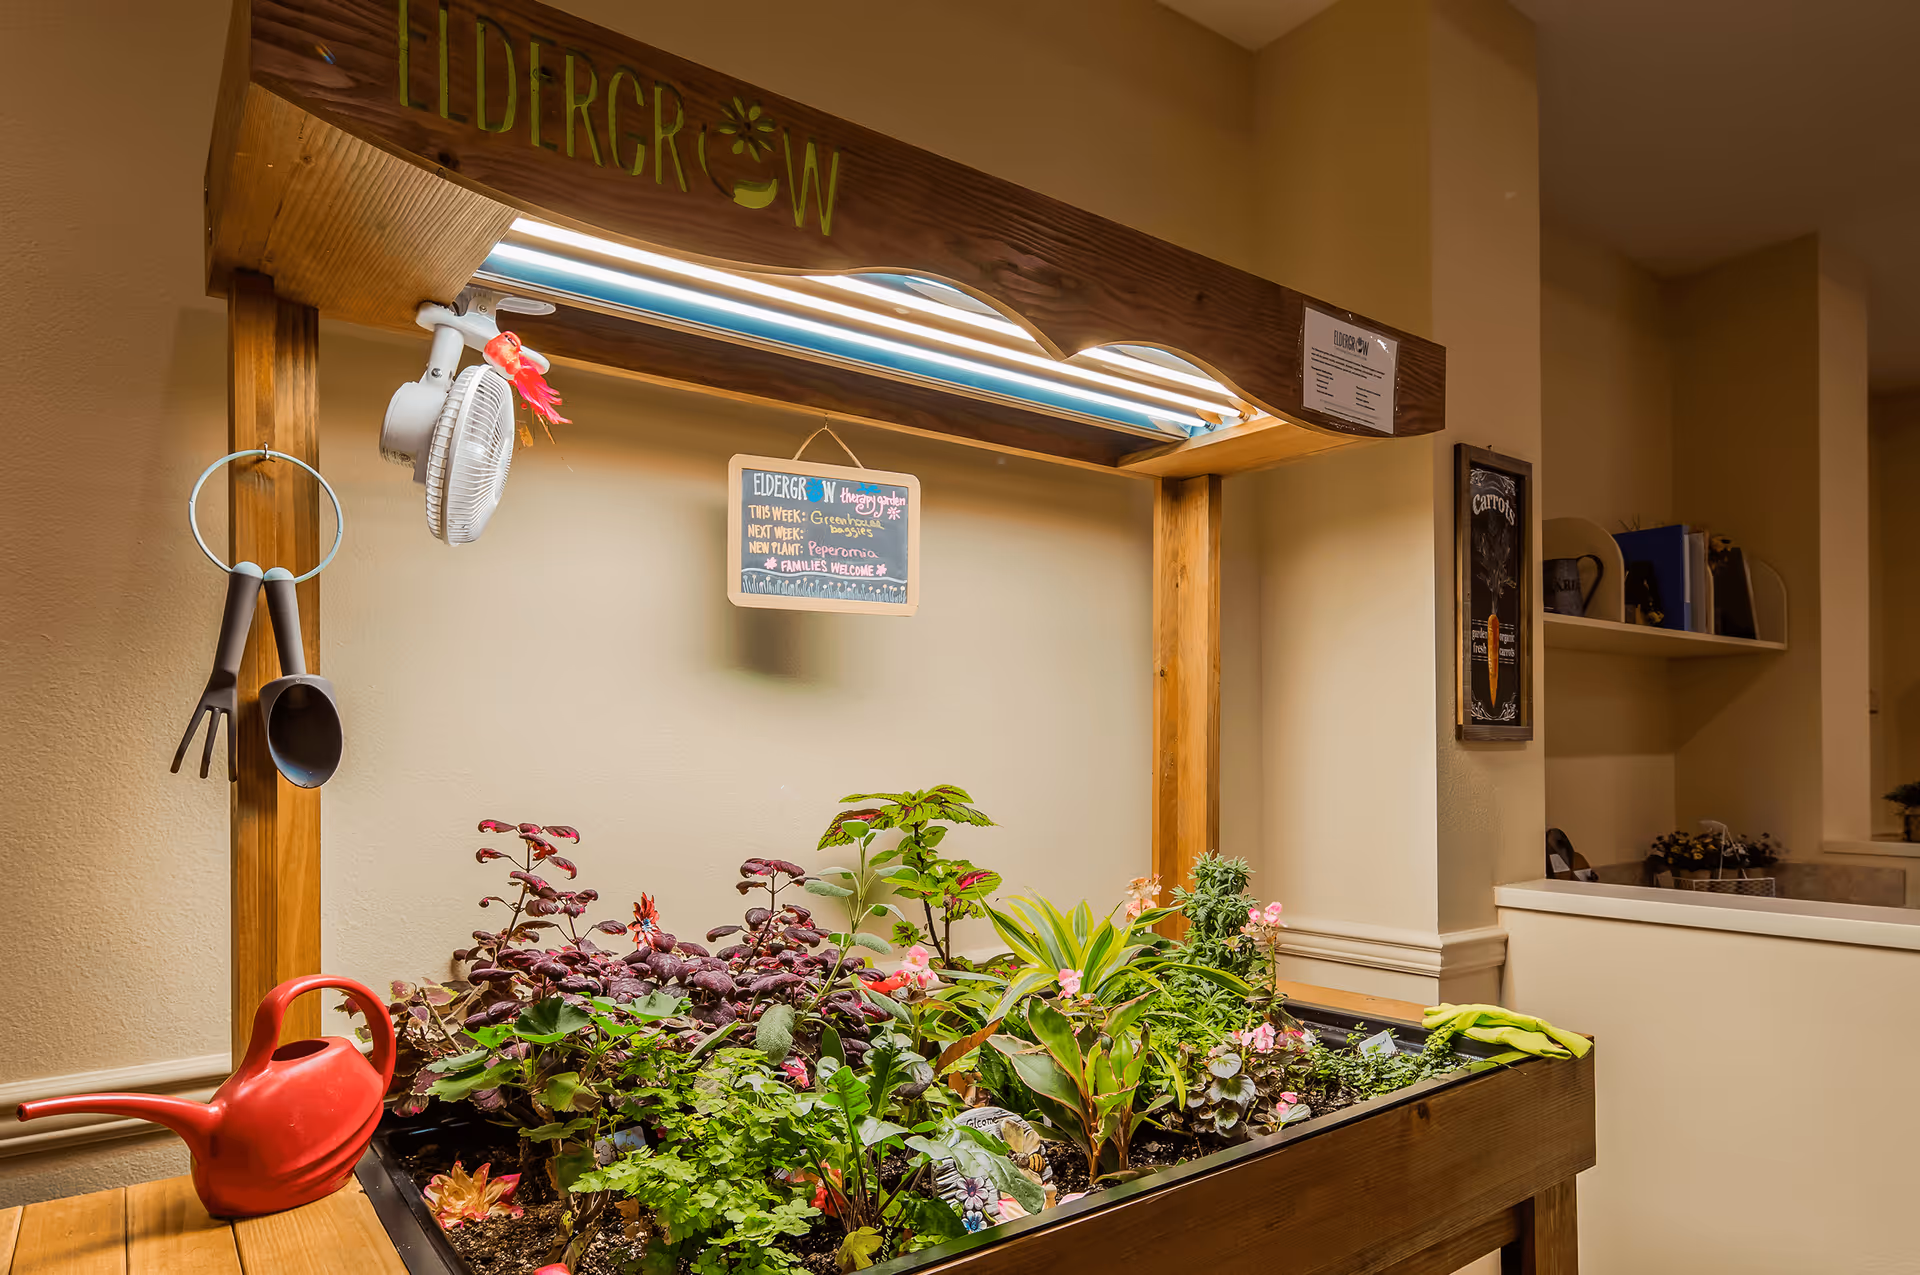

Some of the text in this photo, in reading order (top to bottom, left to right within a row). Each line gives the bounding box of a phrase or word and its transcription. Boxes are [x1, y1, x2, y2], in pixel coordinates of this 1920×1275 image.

[840, 487, 876, 515] therapy
[874, 491, 906, 518] garden
[1473, 493, 1515, 525] Carrots
[748, 505, 770, 519] THIS
[772, 506, 806, 523] WEEK:
[748, 524, 804, 540] NEXT WEEK:
[829, 525, 873, 538] baggies
[749, 540, 879, 558] NEW PLANT: Peperomia
[781, 560, 874, 577] FAMILIES WELCOME
[1472, 627, 1488, 640] garden
[1499, 632, 1515, 645] organic
[1472, 642, 1487, 654] fresh
[1499, 648, 1515, 657] carrots
